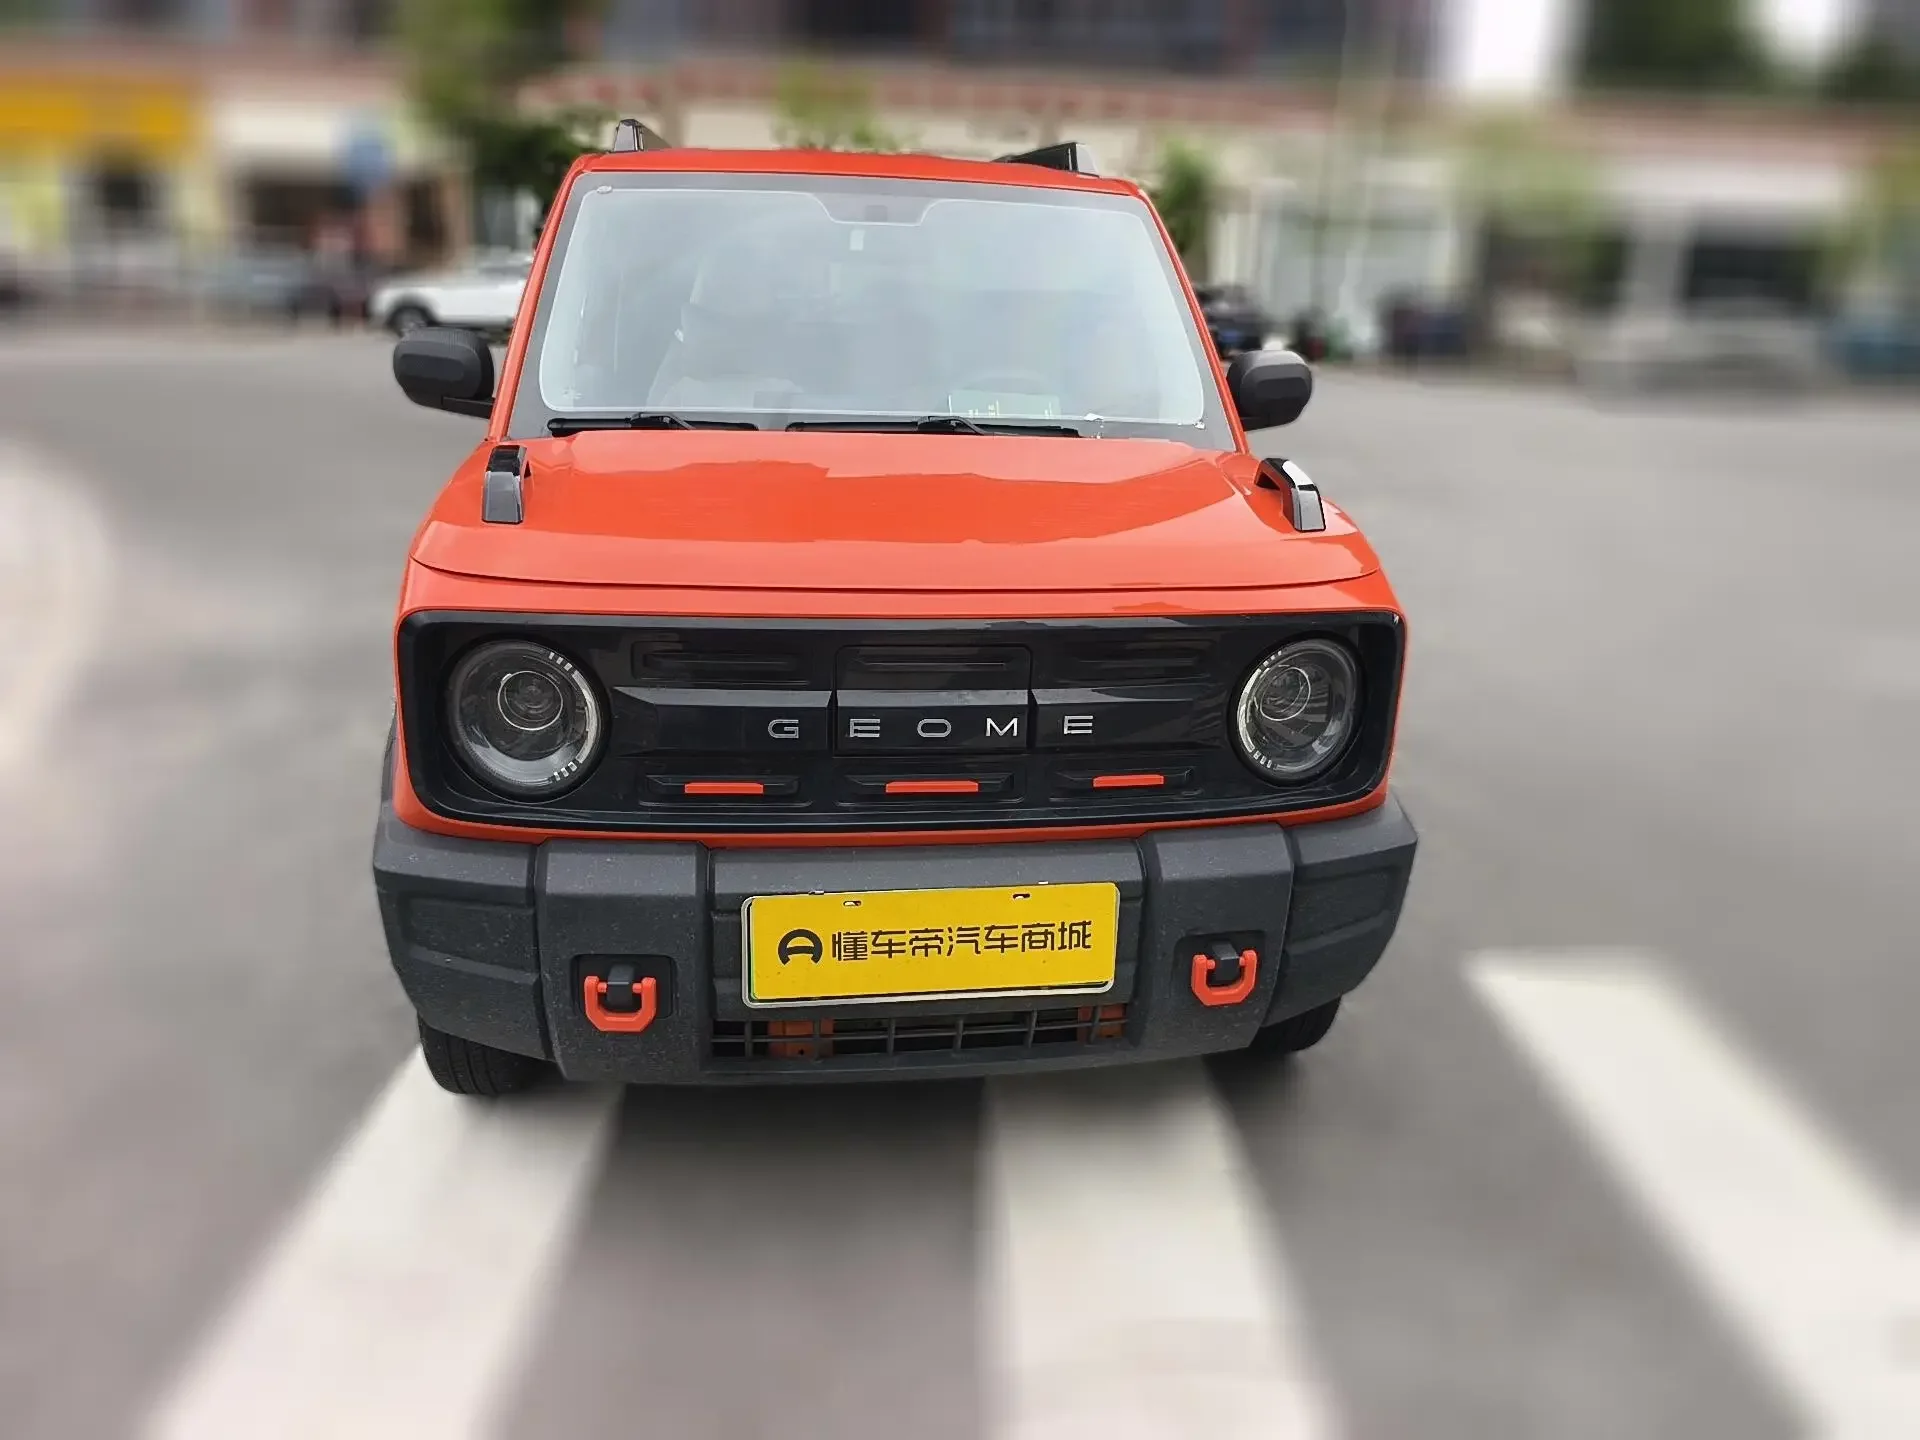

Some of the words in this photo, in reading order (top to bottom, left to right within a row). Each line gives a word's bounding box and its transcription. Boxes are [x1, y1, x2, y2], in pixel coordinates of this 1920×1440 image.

[767, 715, 1094, 739] GEOME
[831, 920, 1092, 961] 懂车帝汽车商城
